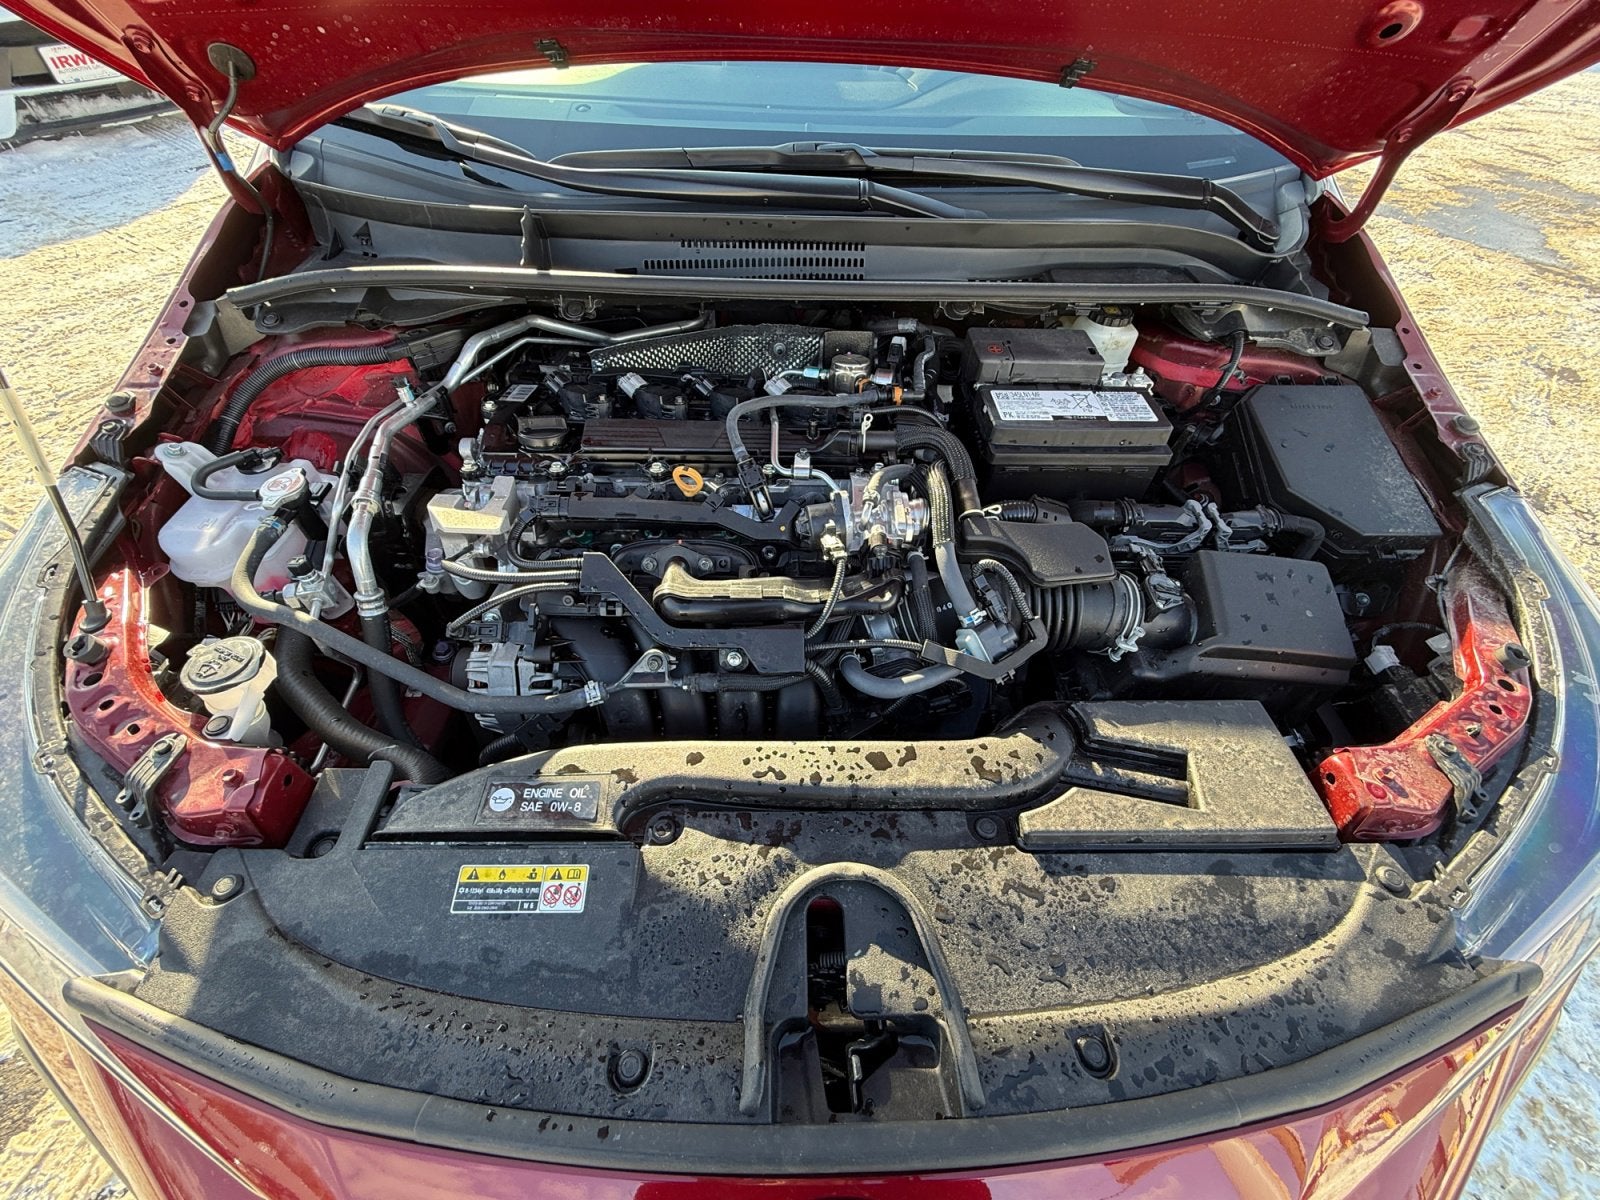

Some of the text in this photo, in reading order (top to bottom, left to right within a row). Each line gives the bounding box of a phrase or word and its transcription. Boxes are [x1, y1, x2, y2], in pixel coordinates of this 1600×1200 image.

[523, 787, 587, 798] ENGINE OIL
[520, 801, 582, 812] SAE 0W-8
